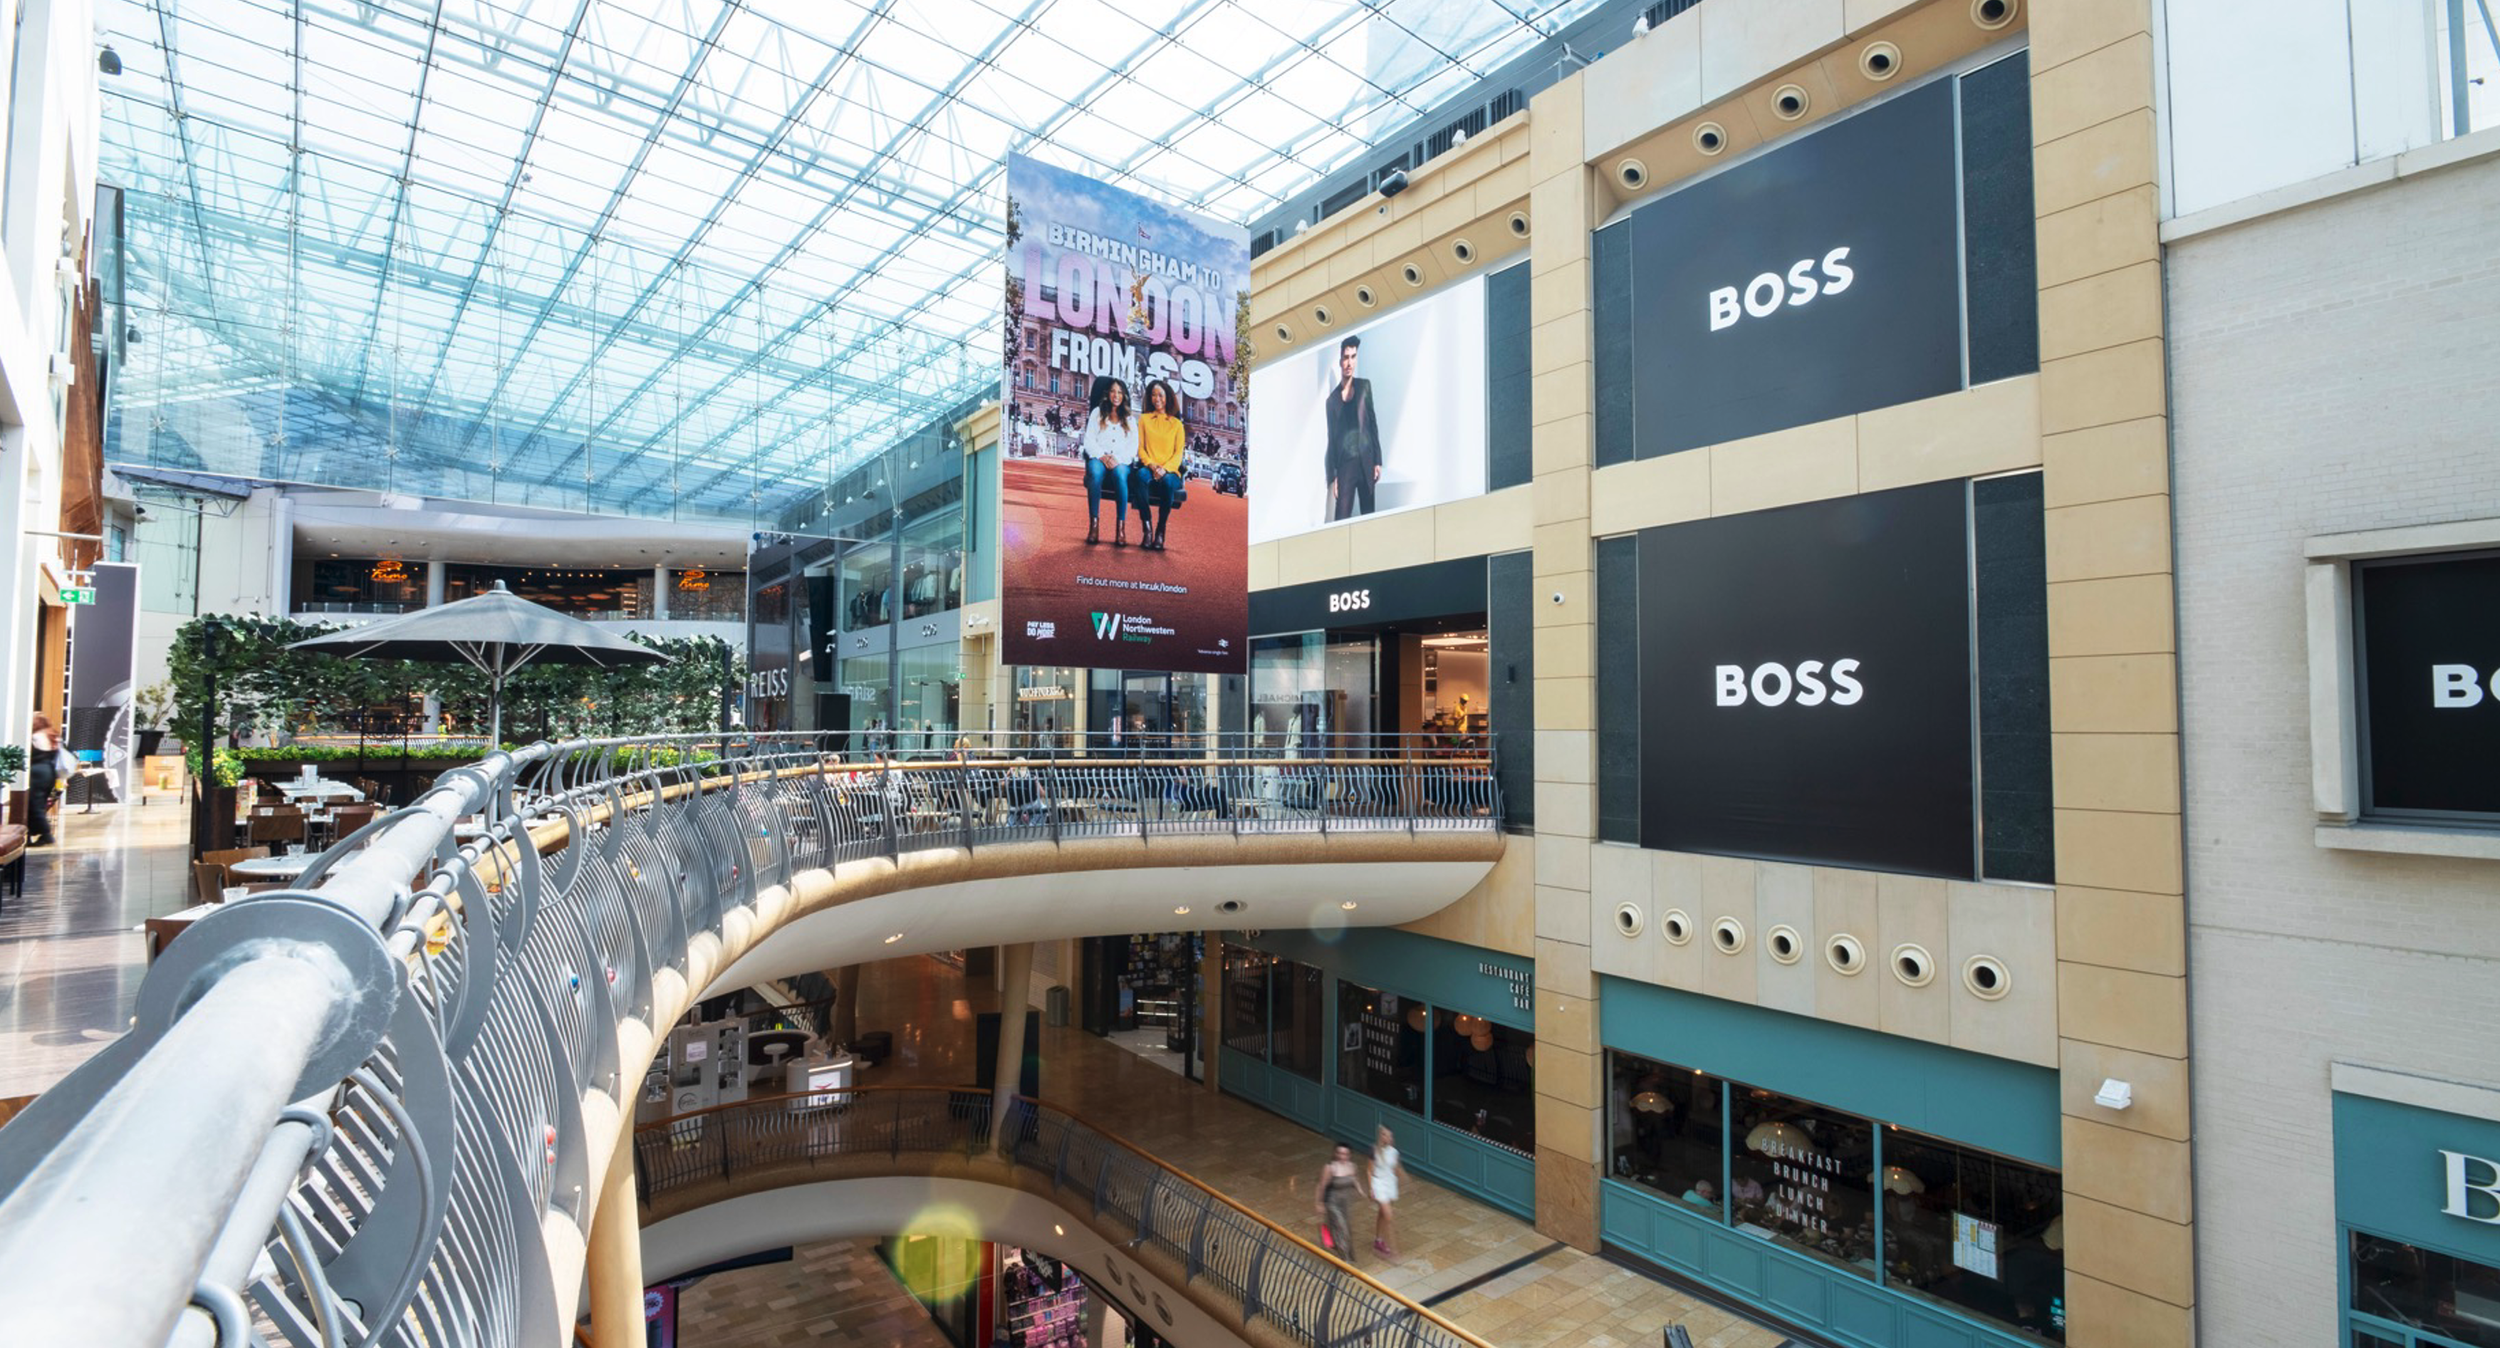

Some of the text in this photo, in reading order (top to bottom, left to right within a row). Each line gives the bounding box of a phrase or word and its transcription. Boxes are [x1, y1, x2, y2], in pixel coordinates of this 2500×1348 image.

[1049, 222, 1221, 290] BIRMINGHAM TO
[1024, 243, 1238, 365] LONDON
[1709, 247, 1854, 332] BOSS
[1051, 328, 1214, 399] FROM £9
[1076, 575, 1093, 585] Find
[1094, 578, 1108, 586] out
[1109, 580, 1128, 589] more
[1130, 581, 1138, 589] at
[1329, 589, 1370, 612] BOSS
[1122, 614, 1152, 625] London
[1122, 624, 1175, 635] Northwestern
[1122, 633, 1152, 645] Railway
[750, 668, 788, 698] REISS
[1715, 658, 1864, 707] BOSS
[1479, 962, 1530, 983] RESTAURANT
[1509, 982, 1530, 997] CAFÉ
[1514, 997, 1530, 1010] BAR
[1761, 1137, 1841, 1175] BREAKFAST
[1773, 1161, 1828, 1192] BRUNCH
[1779, 1183, 1824, 1211] LUNCH
[1776, 1203, 1828, 1234] DINNER
